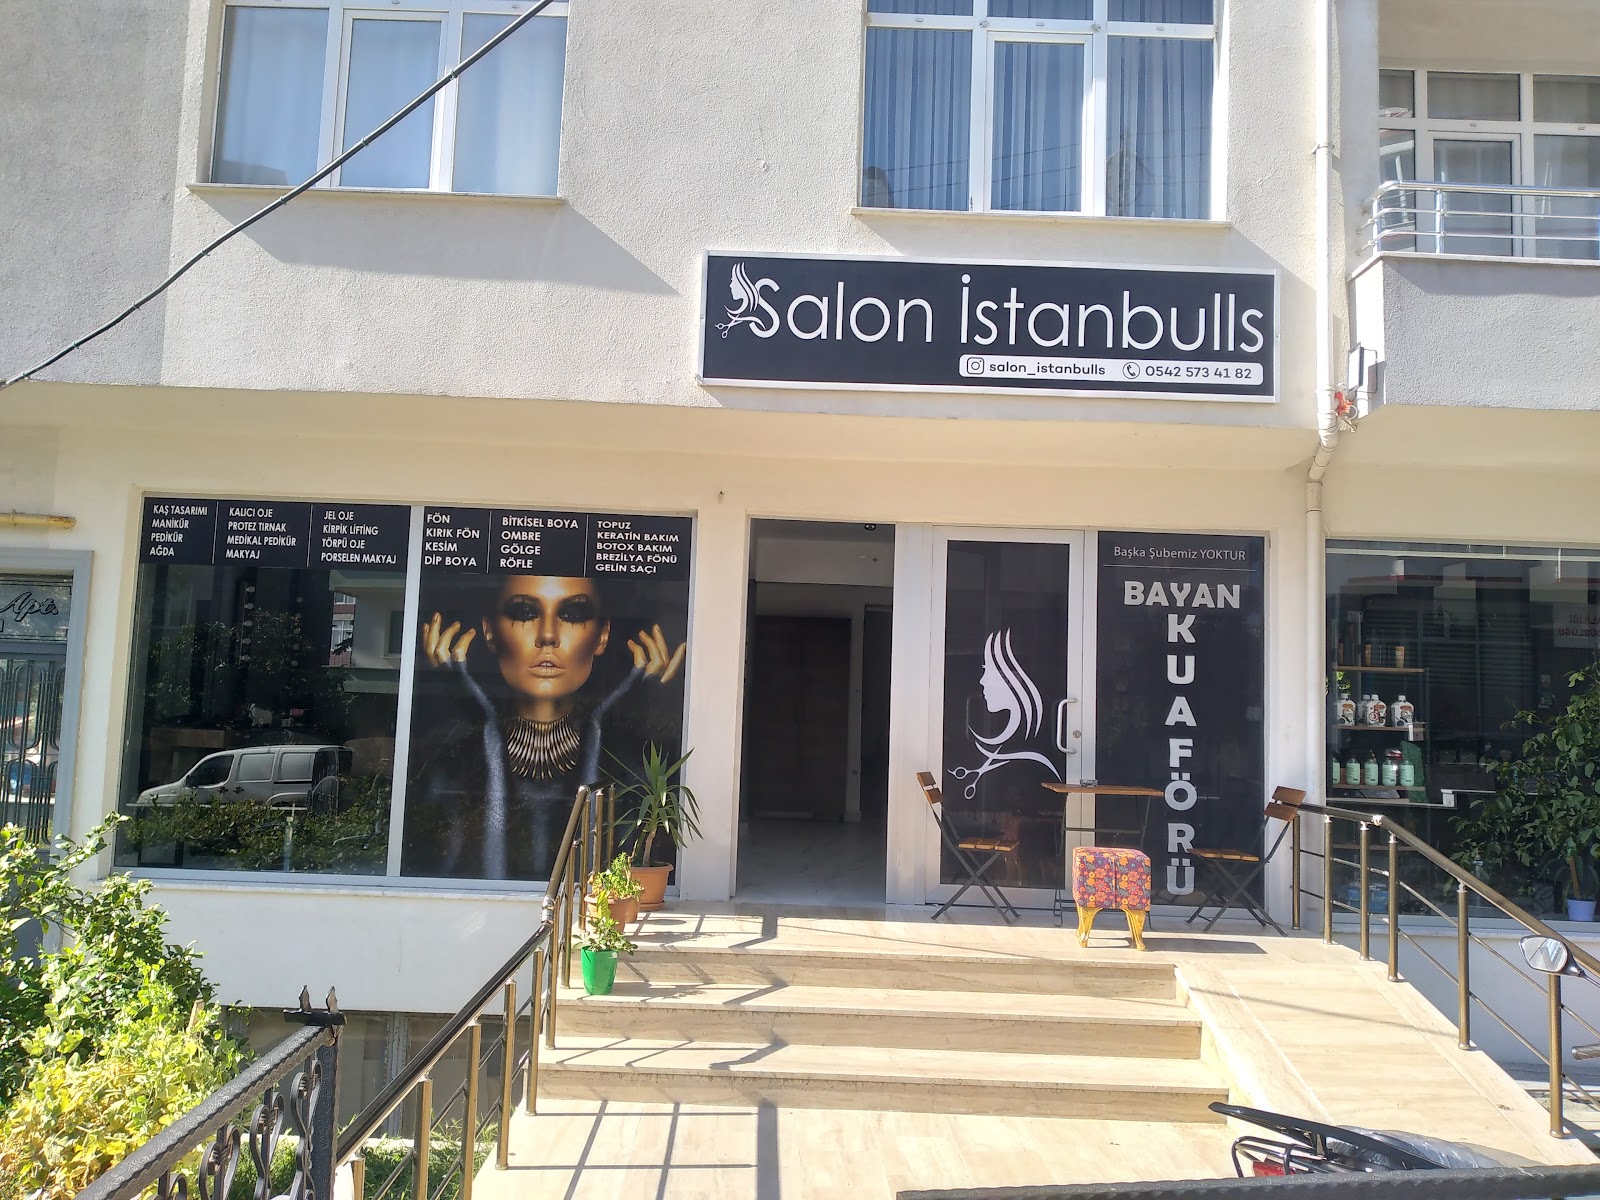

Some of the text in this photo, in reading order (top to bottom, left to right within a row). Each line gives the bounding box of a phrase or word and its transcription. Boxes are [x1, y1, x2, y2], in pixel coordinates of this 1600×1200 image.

[751, 274, 1264, 354] Salon İstanbulls
[989, 361, 1106, 377] salon_istanbulls
[1145, 366, 1252, 380] 0542 573 41 82
[153, 505, 208, 516] KAŞ TASARIMI
[229, 507, 273, 518] KALICI OJE
[324, 511, 354, 521] JEL OJE
[152, 517, 189, 529] MANİKÜR
[427, 513, 450, 524] FÖN
[502, 515, 579, 529] BİTKİSEL BOYA
[228, 521, 287, 533] PROTEZ TIRNAK
[323, 524, 378, 536] KİRPİK LİFTİNG
[597, 521, 631, 529] TOPUZ
[151, 531, 184, 543] PEDİKÜR
[426, 527, 480, 539] KIRIK FÖN
[502, 531, 541, 541] OMBRE
[597, 531, 679, 542] KERATİN BAKIM
[227, 535, 296, 547] MEDİKAL PEDİKÜR
[322, 538, 365, 549] TÖRPÜ OJE
[425, 541, 458, 552] KESİM
[150, 545, 174, 557] AĞDA
[501, 543, 541, 555] GÖLGE
[597, 543, 672, 552] BOTOX BAKIM
[226, 549, 260, 559] MAKYAJ
[321, 553, 397, 564] PORSELEN MAKYAJ
[596, 552, 677, 564] BREZİLYA FÖNÜ
[1114, 547, 1245, 561] Başka Şubemiz YOKTUR
[425, 555, 477, 567] DİP BOYA
[500, 557, 533, 569] RÖFLE
[595, 563, 657, 574] GELİN SAÇI
[1124, 581, 1240, 609] BAYAN
[1164, 614, 1198, 896] KUAFÖRÜ
